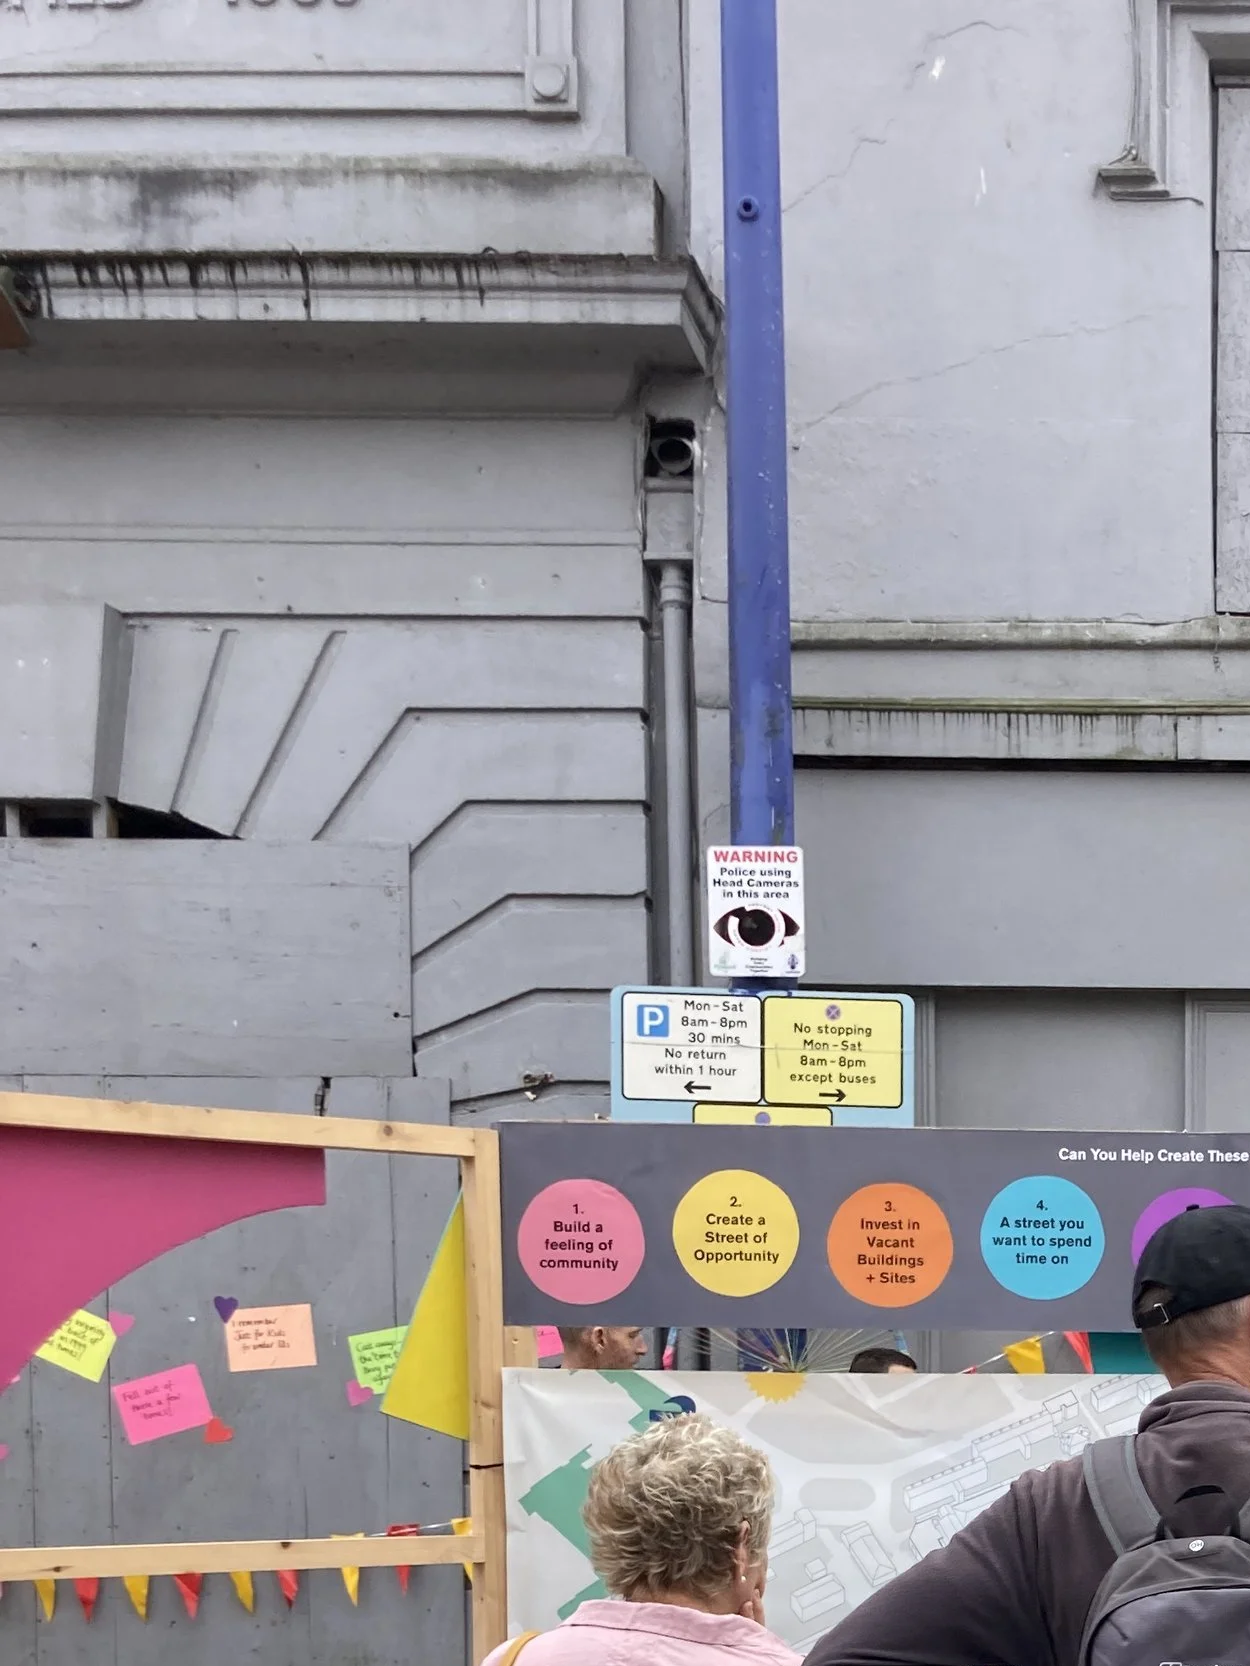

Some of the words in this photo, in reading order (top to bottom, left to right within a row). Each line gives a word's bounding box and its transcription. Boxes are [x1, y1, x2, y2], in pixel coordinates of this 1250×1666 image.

[713, 850, 799, 863] WARNING
[720, 867, 756, 877] Police
[760, 867, 792, 879] using
[713, 878, 743, 888] Head
[747, 879, 799, 888] Cameras
[722, 889, 733, 898] in
[737, 890, 759, 899] this
[762, 891, 790, 899] area
[643, 1007, 664, 1036] P
[794, 1023, 811, 1034] No
[817, 1024, 872, 1037] stopping
[688, 1033, 706, 1044] 30
[711, 1033, 741, 1045] mins
[664, 1048, 682, 1059] No
[688, 1049, 726, 1060] return
[654, 1064, 693, 1075] within
[699, 1065, 704, 1075] 1
[709, 1066, 737, 1077] hour
[790, 1074, 833, 1086] except
[839, 1073, 876, 1084] buses
[1058, 1148, 1086, 1161] Can
[1090, 1148, 1117, 1161] You
[1121, 1149, 1153, 1164] Help
[1157, 1150, 1204, 1162] Create
[1207, 1150, 1249, 1162] These
[730, 1196, 742, 1207] 2.
[884, 1201, 896, 1212] 3.
[1036, 1200, 1048, 1211] 4.
[573, 1204, 584, 1214] 1.
[706, 1213, 753, 1226] Create
[758, 1217, 765, 1226] a
[860, 1218, 903, 1230] Invest
[908, 1219, 920, 1230] in
[1000, 1217, 1010, 1228] A
[1014, 1218, 1055, 1229] street
[1059, 1219, 1084, 1232] you
[553, 1221, 590, 1233] Build
[595, 1224, 603, 1233] a
[705, 1231, 749, 1243] Street
[753, 1232, 768, 1243] of
[867, 1237, 915, 1248] Vacant
[992, 1236, 1027, 1247] want
[1031, 1236, 1045, 1247] to
[1050, 1236, 1091, 1250] spend
[545, 1240, 594, 1253] feeling
[598, 1239, 613, 1250] of
[694, 1249, 779, 1264] Opportunity
[857, 1254, 924, 1267] Buildings
[1016, 1253, 1046, 1264] time
[1051, 1255, 1069, 1265] on
[539, 1258, 619, 1272] community
[866, 1273, 875, 1282] +
[880, 1273, 916, 1284] Sites
